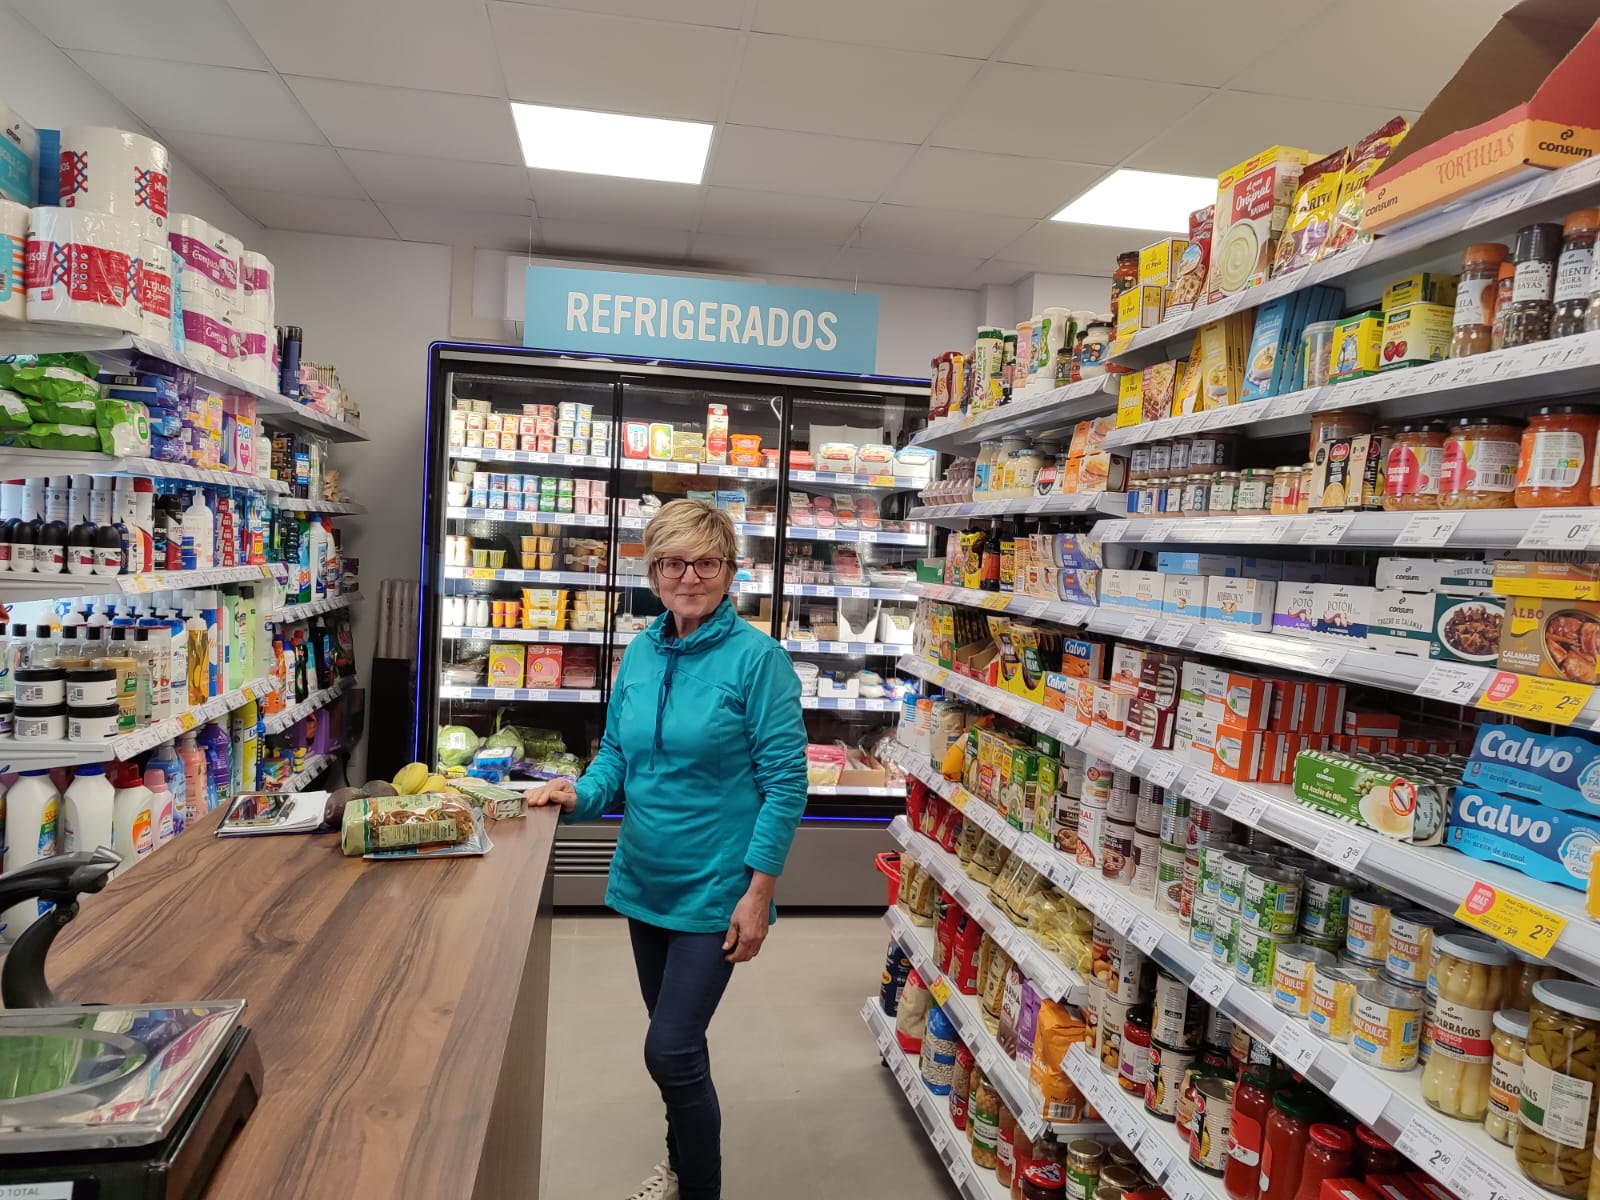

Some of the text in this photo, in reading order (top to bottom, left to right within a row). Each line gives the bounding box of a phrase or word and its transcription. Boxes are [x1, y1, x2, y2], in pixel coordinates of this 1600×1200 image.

[1538, 141, 1593, 158] consum
[1436, 133, 1514, 185] TORTILLAS
[1235, 175, 1272, 212] Original
[1365, 194, 1398, 218] consum
[566, 291, 839, 351] REFRIGERADOS
[1395, 573, 1420, 581] consum
[1389, 606, 1414, 614] consum
[1511, 607, 1545, 620] ALBO
[1064, 641, 1087, 656] Calvo
[1046, 674, 1067, 691] Calvo
[1480, 730, 1573, 773] Calvo
[1489, 773, 1510, 785] aceite
[1509, 777, 1518, 786] de
[1459, 794, 1552, 844] Calvo
[1472, 840, 1492, 852] aceite
[1492, 845, 1501, 855] de
[1355, 921, 1374, 935] DULCE
[1397, 939, 1420, 955] DULCE
[1284, 977, 1305, 990] DULCE
[1316, 996, 1336, 1012] DULCE
[1364, 1023, 1389, 1041] DULCE
[8, 1187, 40, 1197] TOTAL
